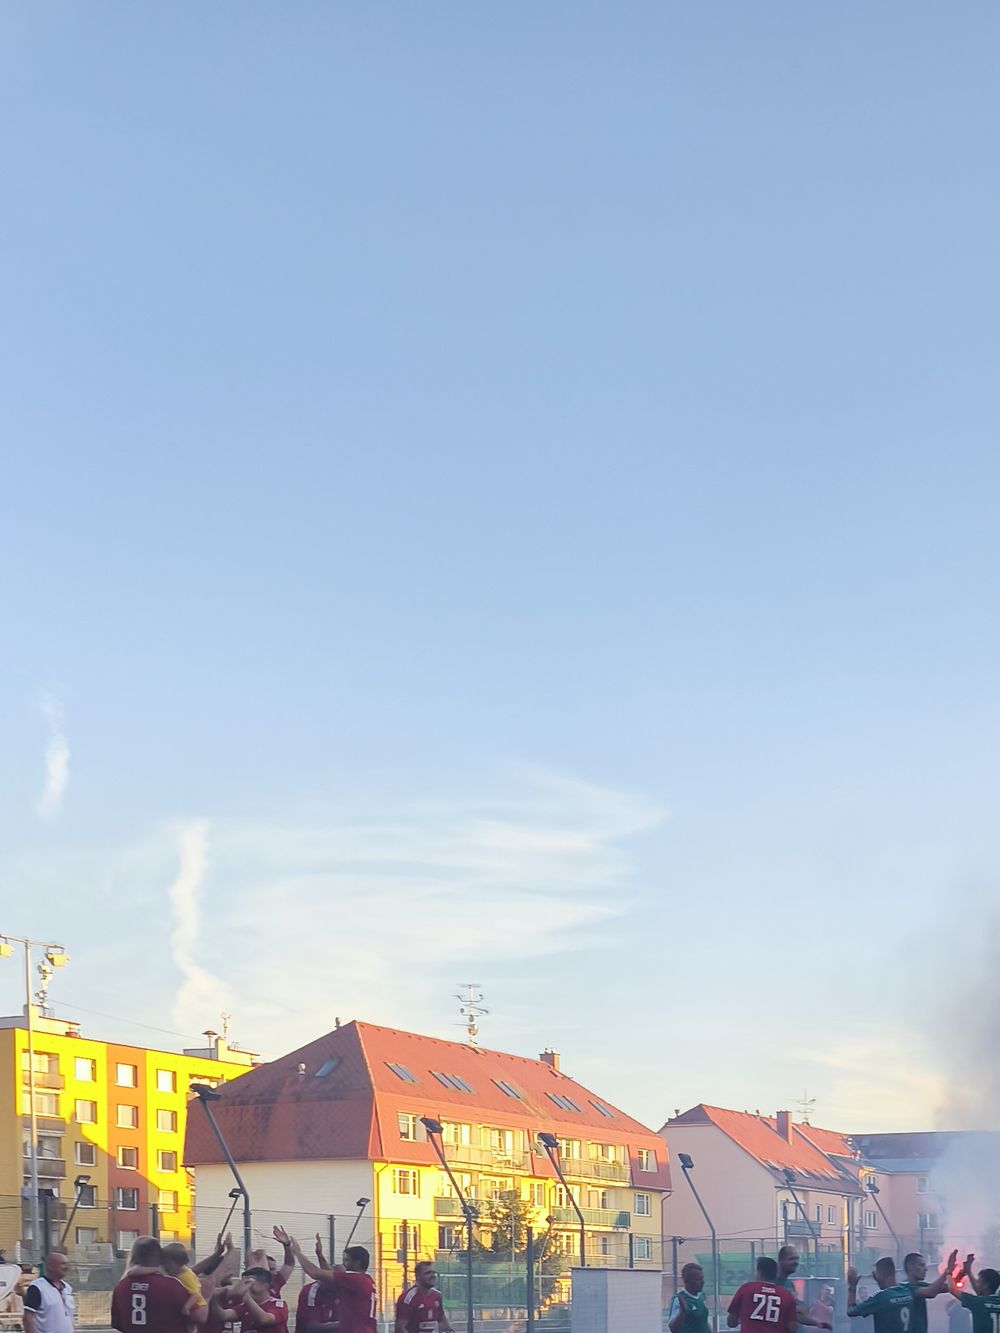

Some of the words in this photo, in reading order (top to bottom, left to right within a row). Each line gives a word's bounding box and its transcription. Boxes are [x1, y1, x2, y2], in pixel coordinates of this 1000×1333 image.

[132, 1293, 147, 1325] 8
[750, 1293, 781, 1323] 26
[900, 1306, 910, 1331] 9
